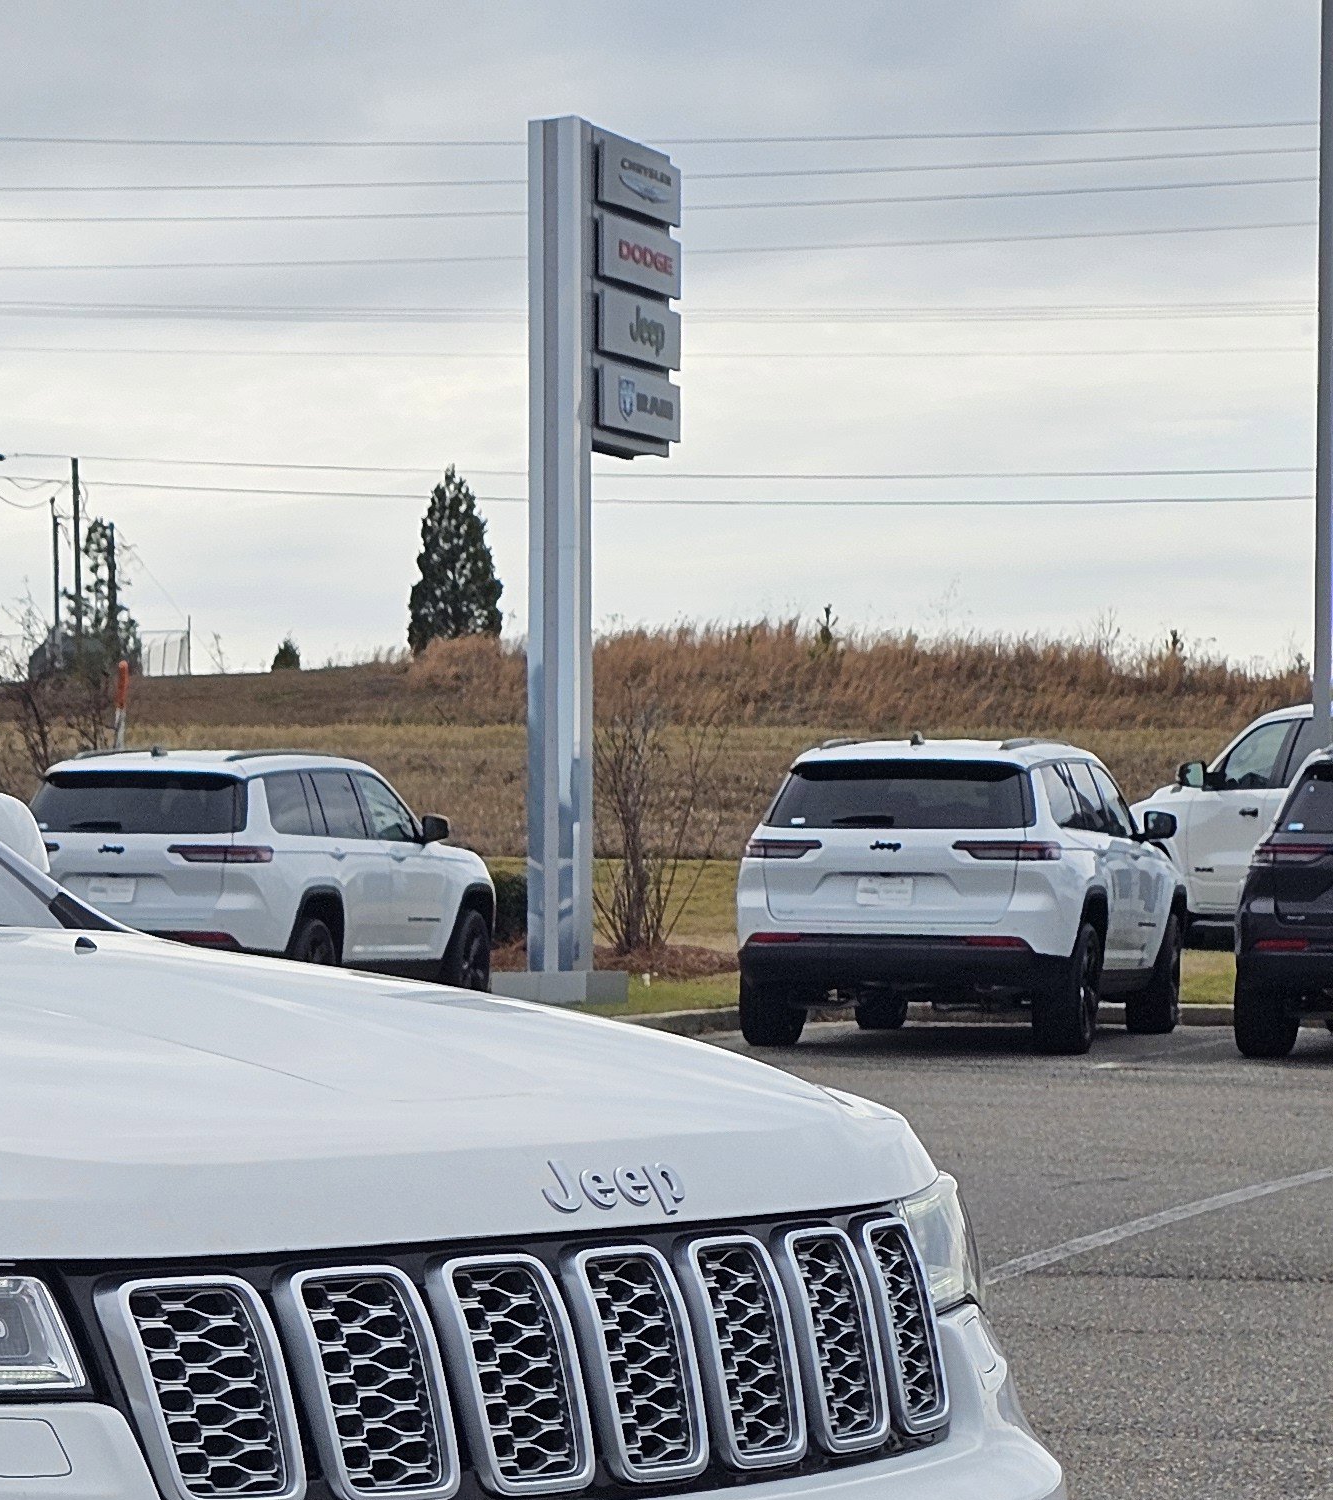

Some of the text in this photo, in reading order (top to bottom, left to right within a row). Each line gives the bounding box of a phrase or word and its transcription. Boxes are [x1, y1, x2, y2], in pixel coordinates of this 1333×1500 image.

[620, 157, 672, 187] CHRYSLER
[618, 239, 674, 277] DODGE
[629, 304, 665, 357] Jeep
[541, 1160, 686, 1215] Jeep
